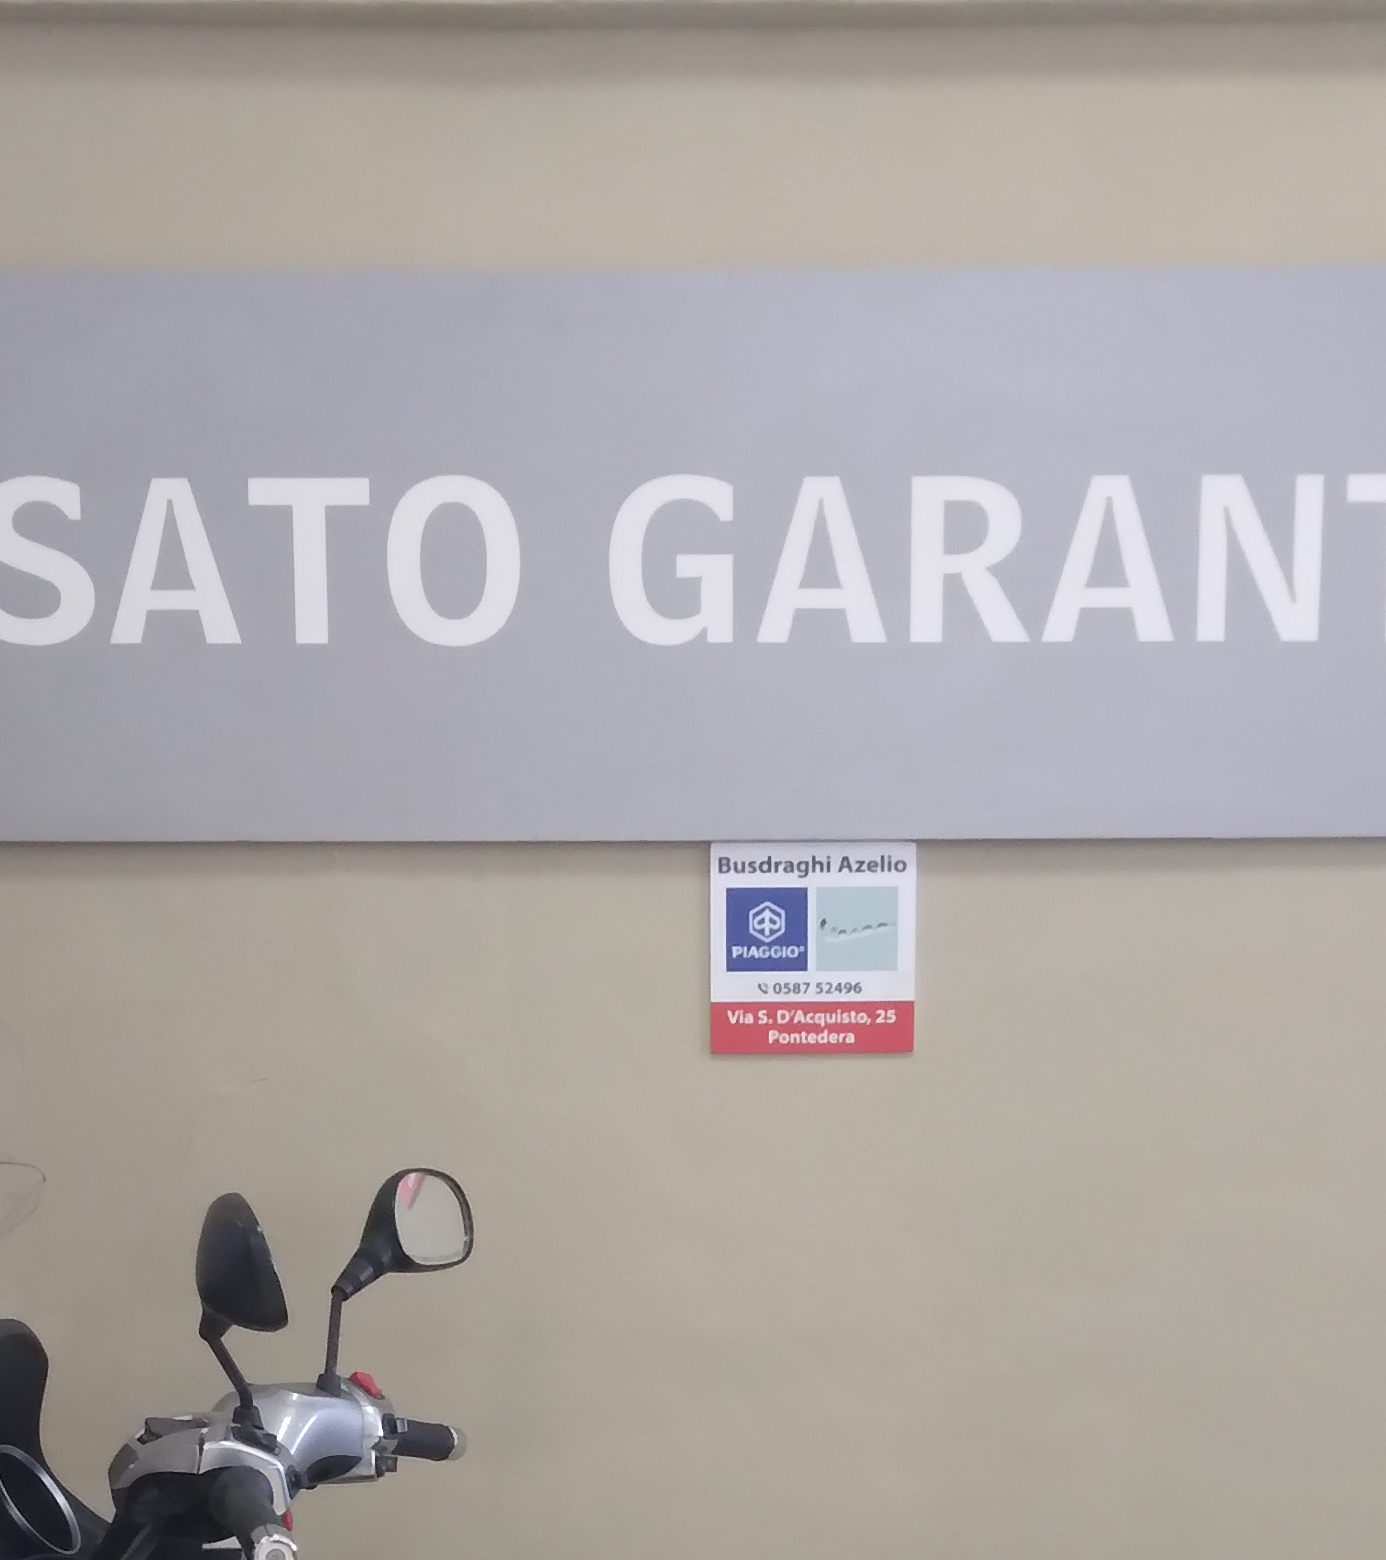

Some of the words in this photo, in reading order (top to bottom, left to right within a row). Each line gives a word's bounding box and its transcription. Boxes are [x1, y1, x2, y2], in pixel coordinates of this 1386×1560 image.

[718, 856, 832, 879] Busdraghi
[838, 855, 908, 873] Azelio
[772, 982, 811, 995] 0587
[815, 981, 863, 995] 52496
[727, 1010, 754, 1024] Via
[758, 1010, 773, 1024] S.
[776, 1010, 871, 1027] D'Acquisto,
[875, 1010, 897, 1023] 25
[768, 1030, 856, 1045] Pontedera
